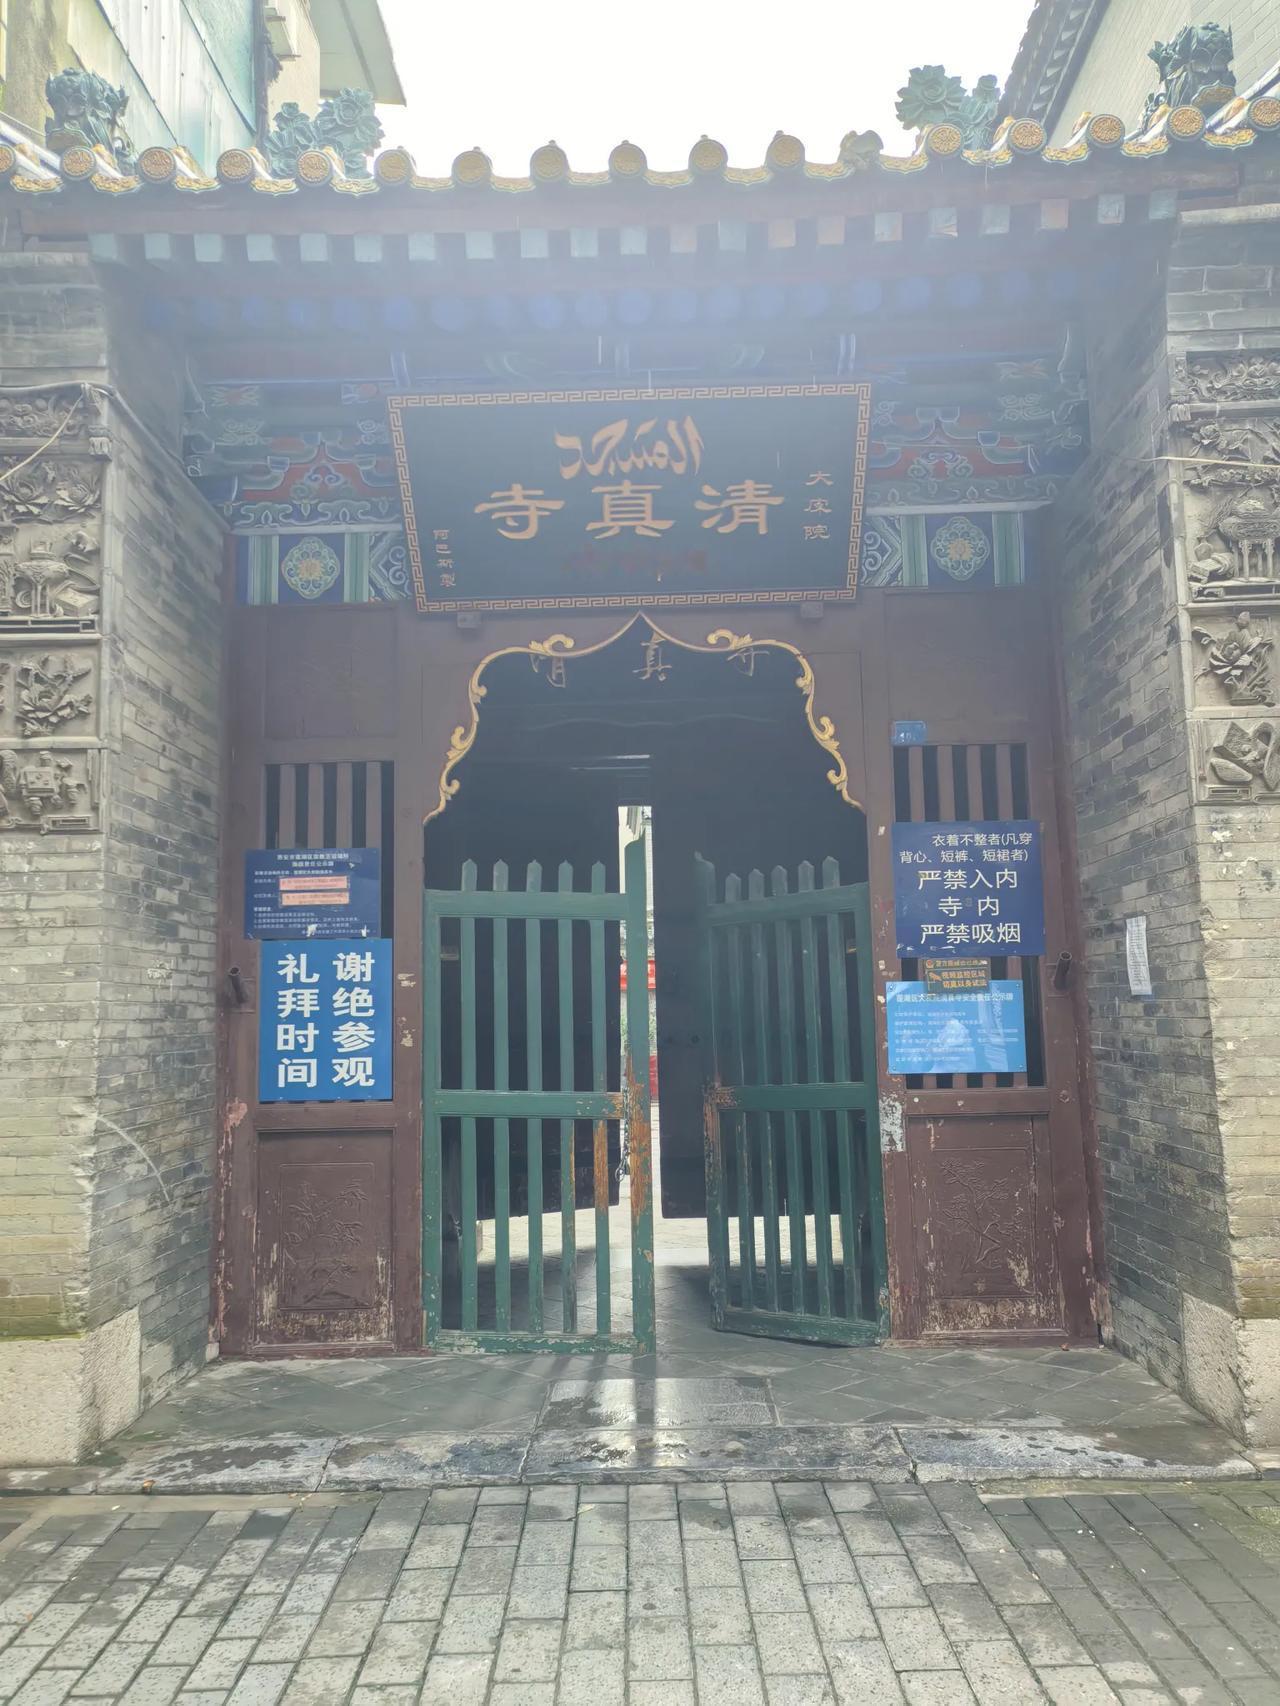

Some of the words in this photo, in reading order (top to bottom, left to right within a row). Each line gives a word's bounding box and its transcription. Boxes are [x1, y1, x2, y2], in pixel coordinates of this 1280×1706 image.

[932, 832, 1033, 847] 衣着不整者(凡穿
[900, 849, 1029, 864] 背心、短裤、短裙者)
[917, 868, 1018, 890] 严禁入内
[920, 923, 1021, 945] 严禁吸烟
[276, 953, 320, 1088] 礼拜时间
[331, 951, 376, 1088] 谢绝参观
